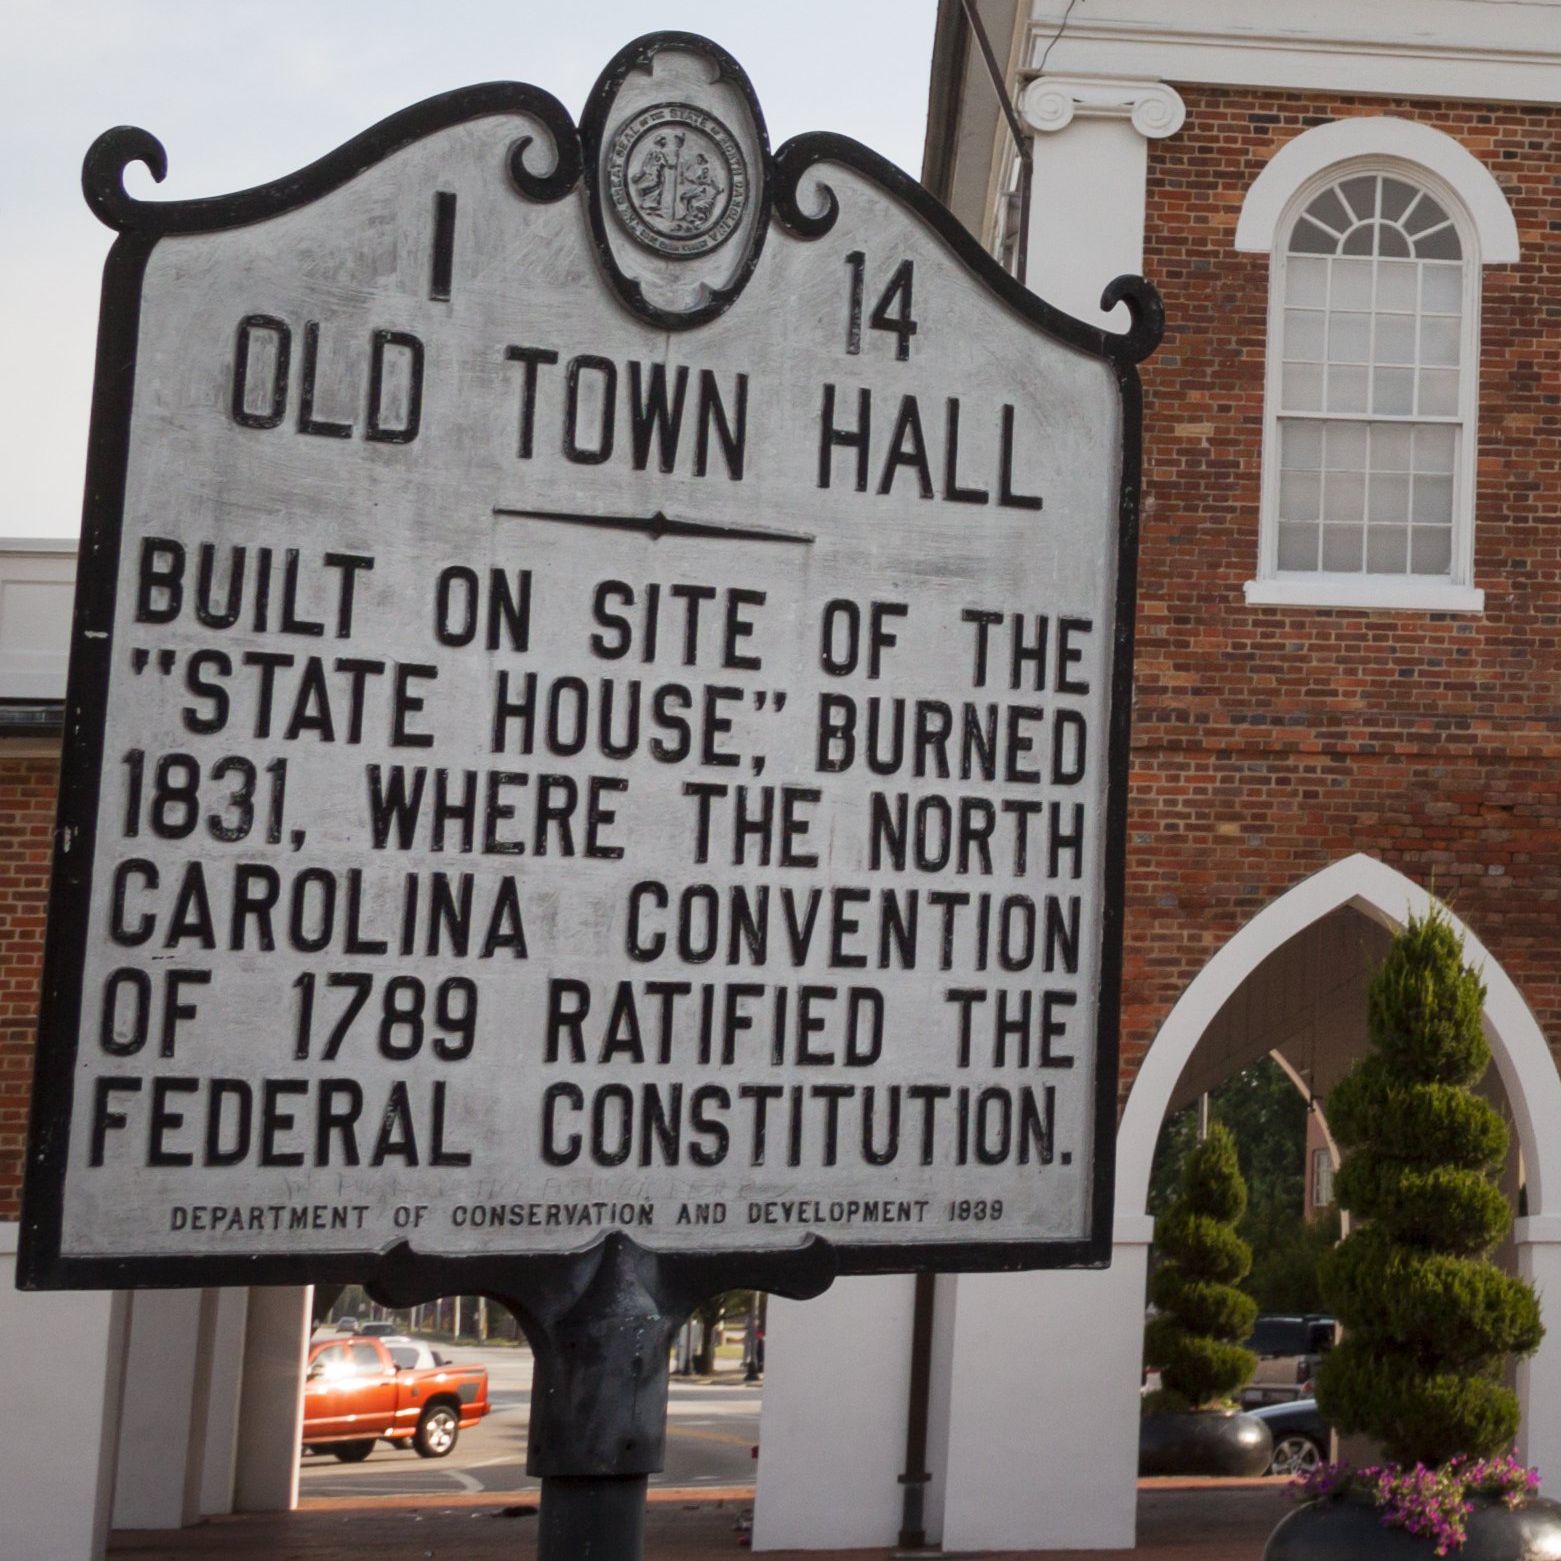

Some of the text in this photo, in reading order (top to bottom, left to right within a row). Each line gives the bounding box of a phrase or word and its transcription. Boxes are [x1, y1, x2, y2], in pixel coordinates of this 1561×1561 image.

[615, 126, 641, 158] SEAL
[669, 108, 708, 129] STATE
[845, 250, 918, 362] 14
[230, 314, 1043, 511] OLD TOWN HALL
[134, 536, 1093, 696] BUILT ON SITE OF THE
[132, 647, 438, 746] "STATE
[816, 693, 1090, 786] BURNED
[122, 749, 1085, 880] 1831, WHERE THE NORTH
[109, 858, 1081, 975] CAROLINA CONVENTION
[99, 966, 1077, 1069] OF 1789 RATIFIED THE
[87, 1075, 1072, 1169] FEDERAL CONSTITUTION.
[169, 1199, 1004, 1232] DEPARTMENT OF CONSERVATION AND DEVELOPMENT 1939
